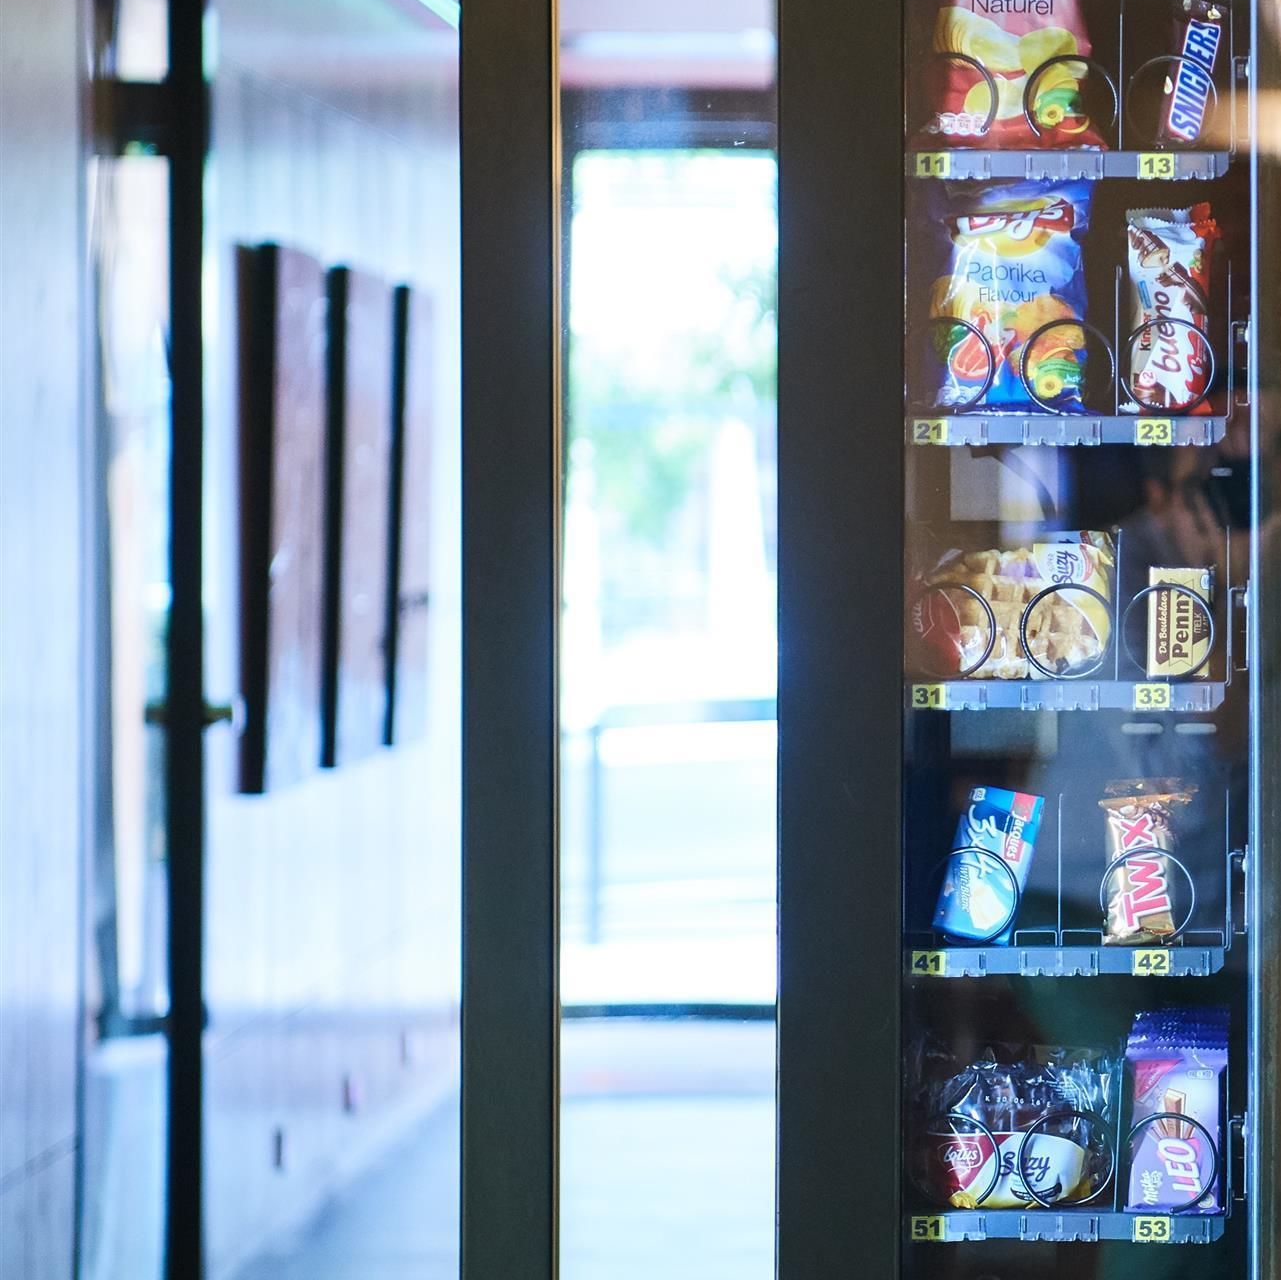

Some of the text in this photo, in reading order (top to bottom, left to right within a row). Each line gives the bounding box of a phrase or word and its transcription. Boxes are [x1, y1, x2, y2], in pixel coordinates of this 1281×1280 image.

[1170, 20, 1221, 138] SNICKERS
[920, 156, 947, 175] 11
[1143, 155, 1172, 175] 13
[955, 203, 1067, 241] Lys
[966, 261, 1048, 286] Paprika
[978, 286, 1038, 303] Flavour
[1153, 291, 1182, 373] bueno
[916, 423, 943, 441] 21
[1139, 423, 1169, 441] 23
[1051, 550, 1079, 584] Suzy
[1157, 590, 1169, 655] De Beukelaer
[914, 687, 941, 705] 31
[1138, 687, 1168, 705] 33
[1005, 811, 1027, 860] Jacques
[1119, 815, 1170, 929] TWIX
[914, 954, 941, 971] 41
[1137, 953, 1167, 971] 42
[1157, 1138, 1202, 1192] LEO
[1139, 1169, 1159, 1205] Milka
[914, 1220, 941, 1237] 51
[1138, 1220, 1167, 1238] 53
